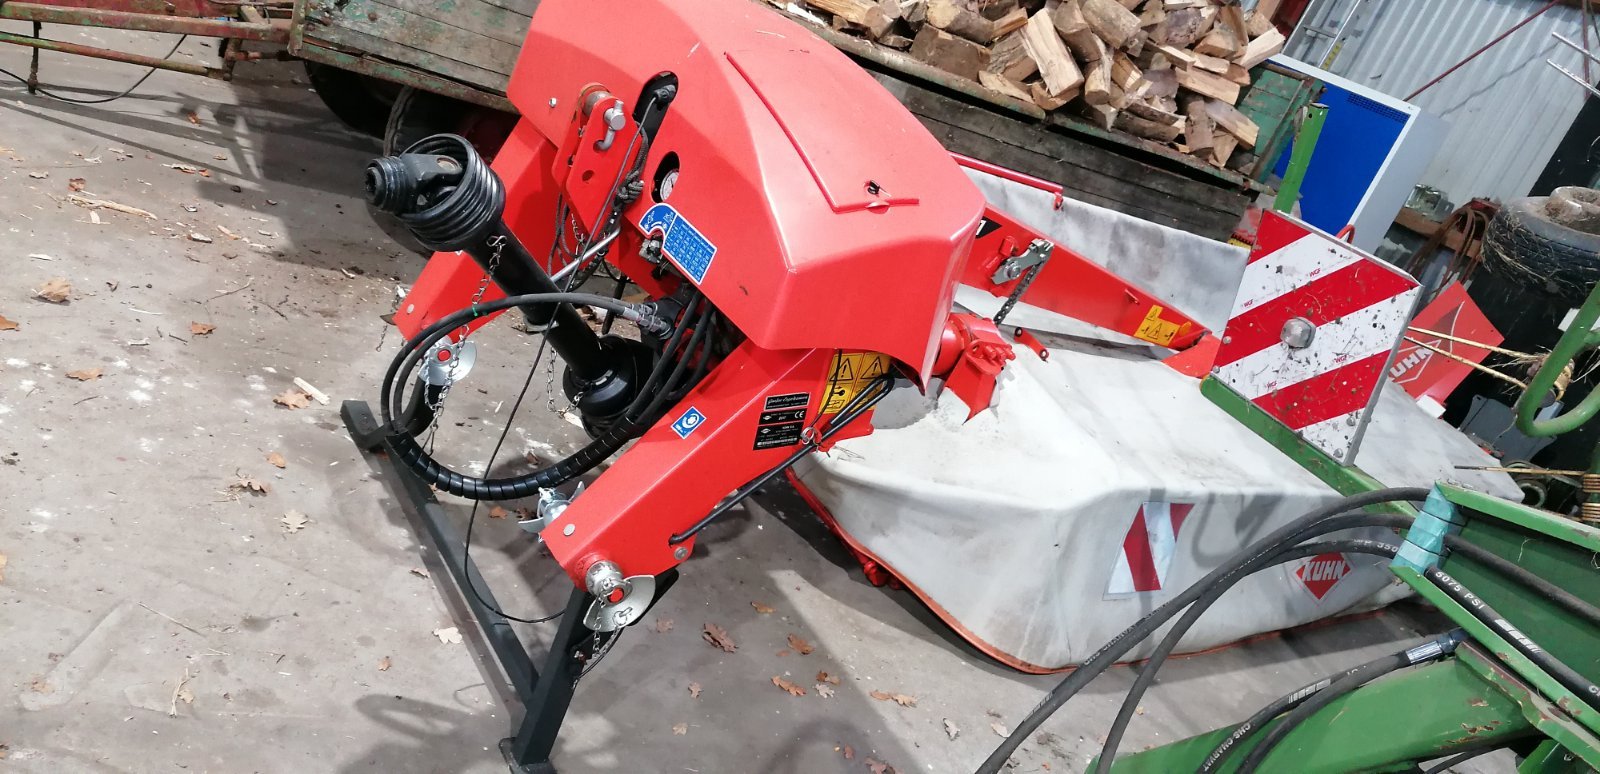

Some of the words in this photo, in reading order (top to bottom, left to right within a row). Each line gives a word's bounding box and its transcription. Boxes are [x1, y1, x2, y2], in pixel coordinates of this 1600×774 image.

[1309, 268, 1321, 277] WGF
[1388, 347, 1435, 382] UHN
[1301, 560, 1346, 582] KUHN
[1434, 571, 1462, 592] 5075
[1463, 593, 1486, 610] PSI
